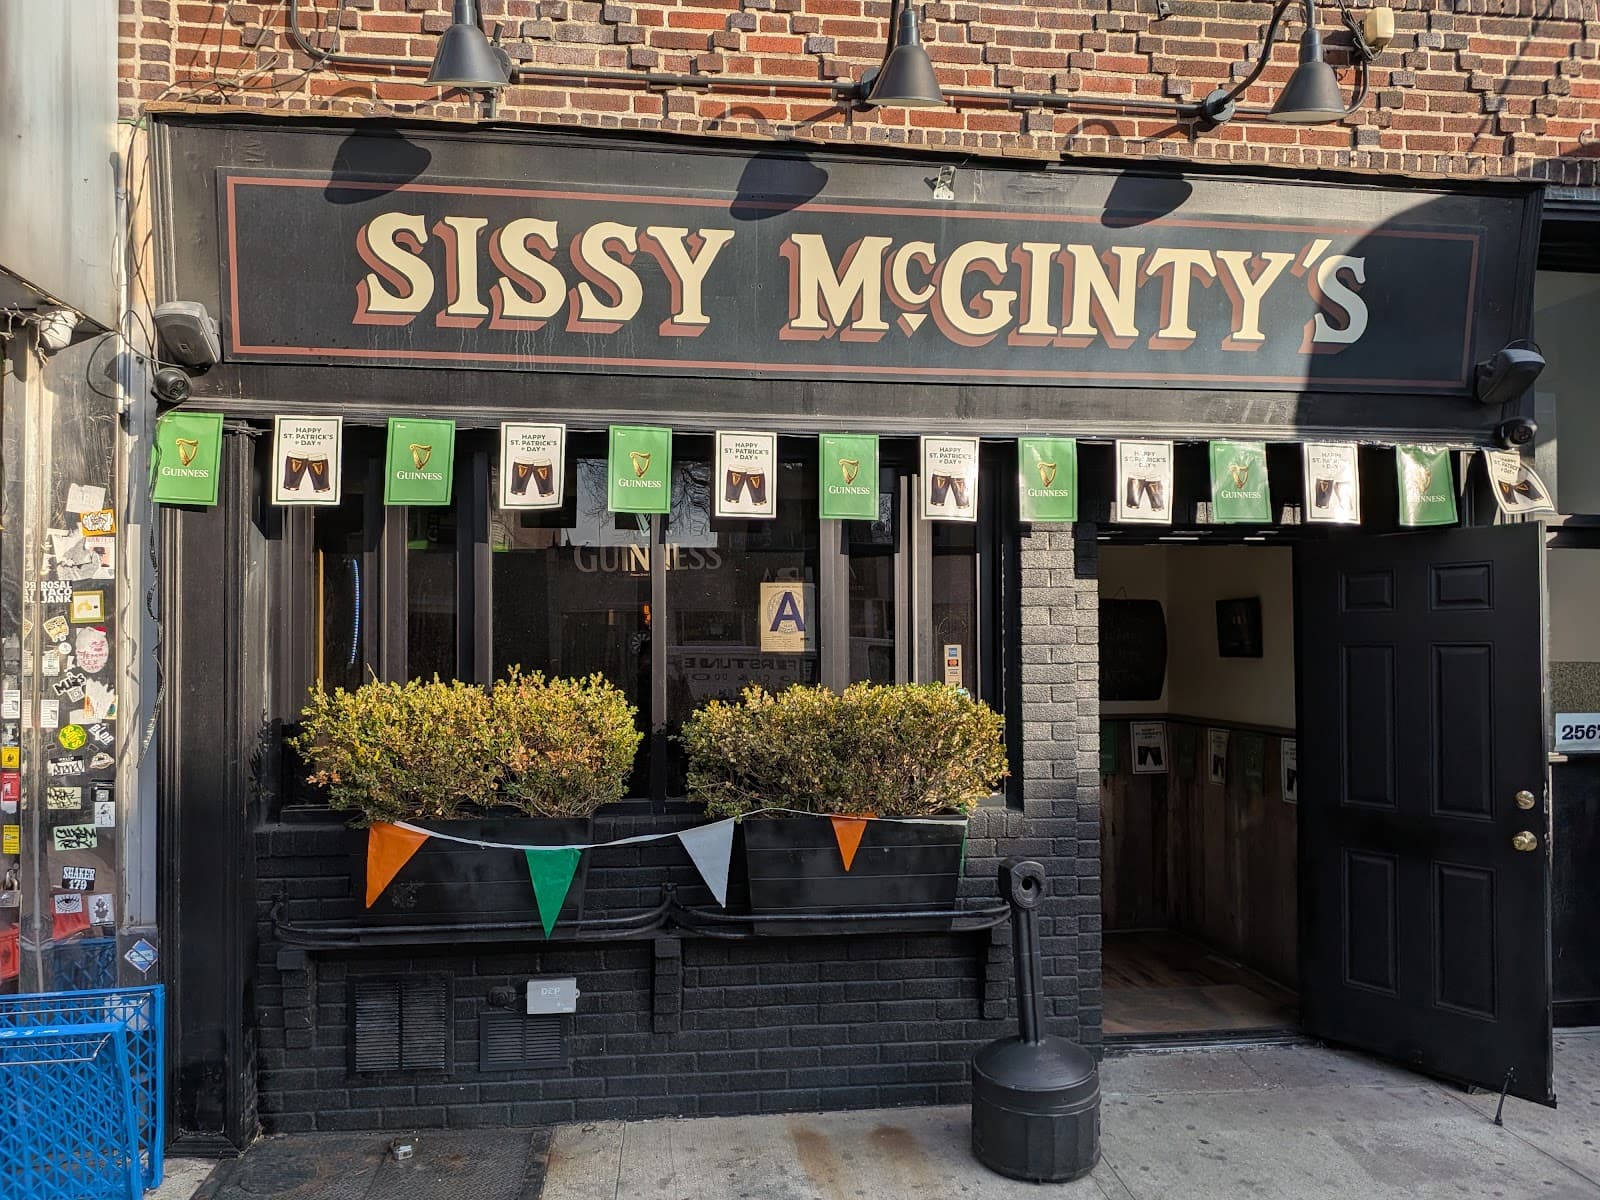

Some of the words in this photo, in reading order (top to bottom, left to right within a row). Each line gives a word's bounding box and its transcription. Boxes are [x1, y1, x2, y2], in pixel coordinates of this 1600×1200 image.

[353, 212, 735, 337] SISSY
[162, 466, 209, 478] GUINNESS
[396, 470, 443, 481] GUINNESS
[618, 479, 662, 488] GUINNESS
[828, 485, 871, 495] GUINNESS
[1027, 488, 1069, 497] GUINNESS
[1221, 490, 1262, 499] GUINNESS
[574, 544, 722, 574] GUINESS
[41, 588, 73, 596] TACO
[769, 592, 806, 631] A
[63, 866, 96, 880] SHAKER
[69, 879, 87, 890] 179
